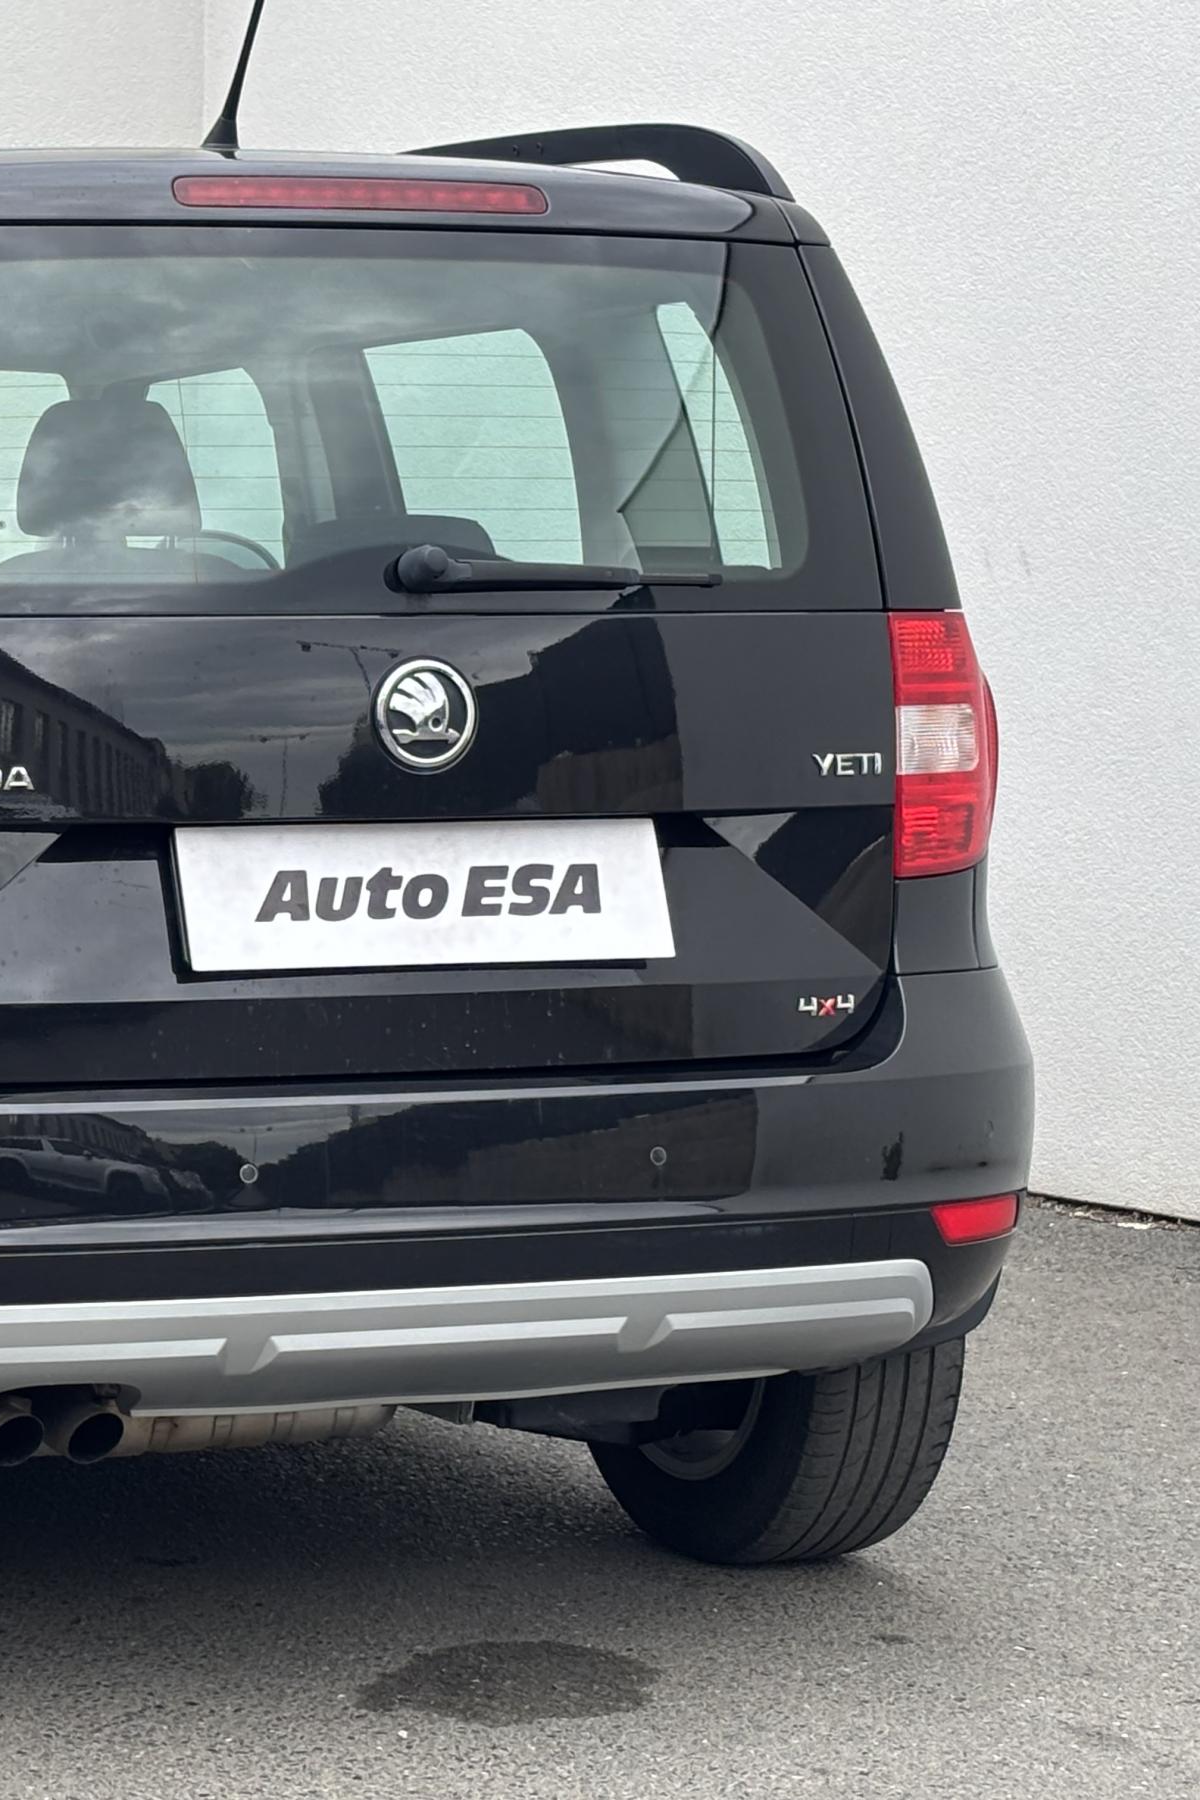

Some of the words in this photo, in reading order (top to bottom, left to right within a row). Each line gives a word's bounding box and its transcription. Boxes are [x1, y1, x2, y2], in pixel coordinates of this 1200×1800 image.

[812, 752, 882, 776] YETI
[255, 867, 449, 922] Auto
[461, 863, 601, 917] ESA
[798, 994, 854, 1016] 4x4
